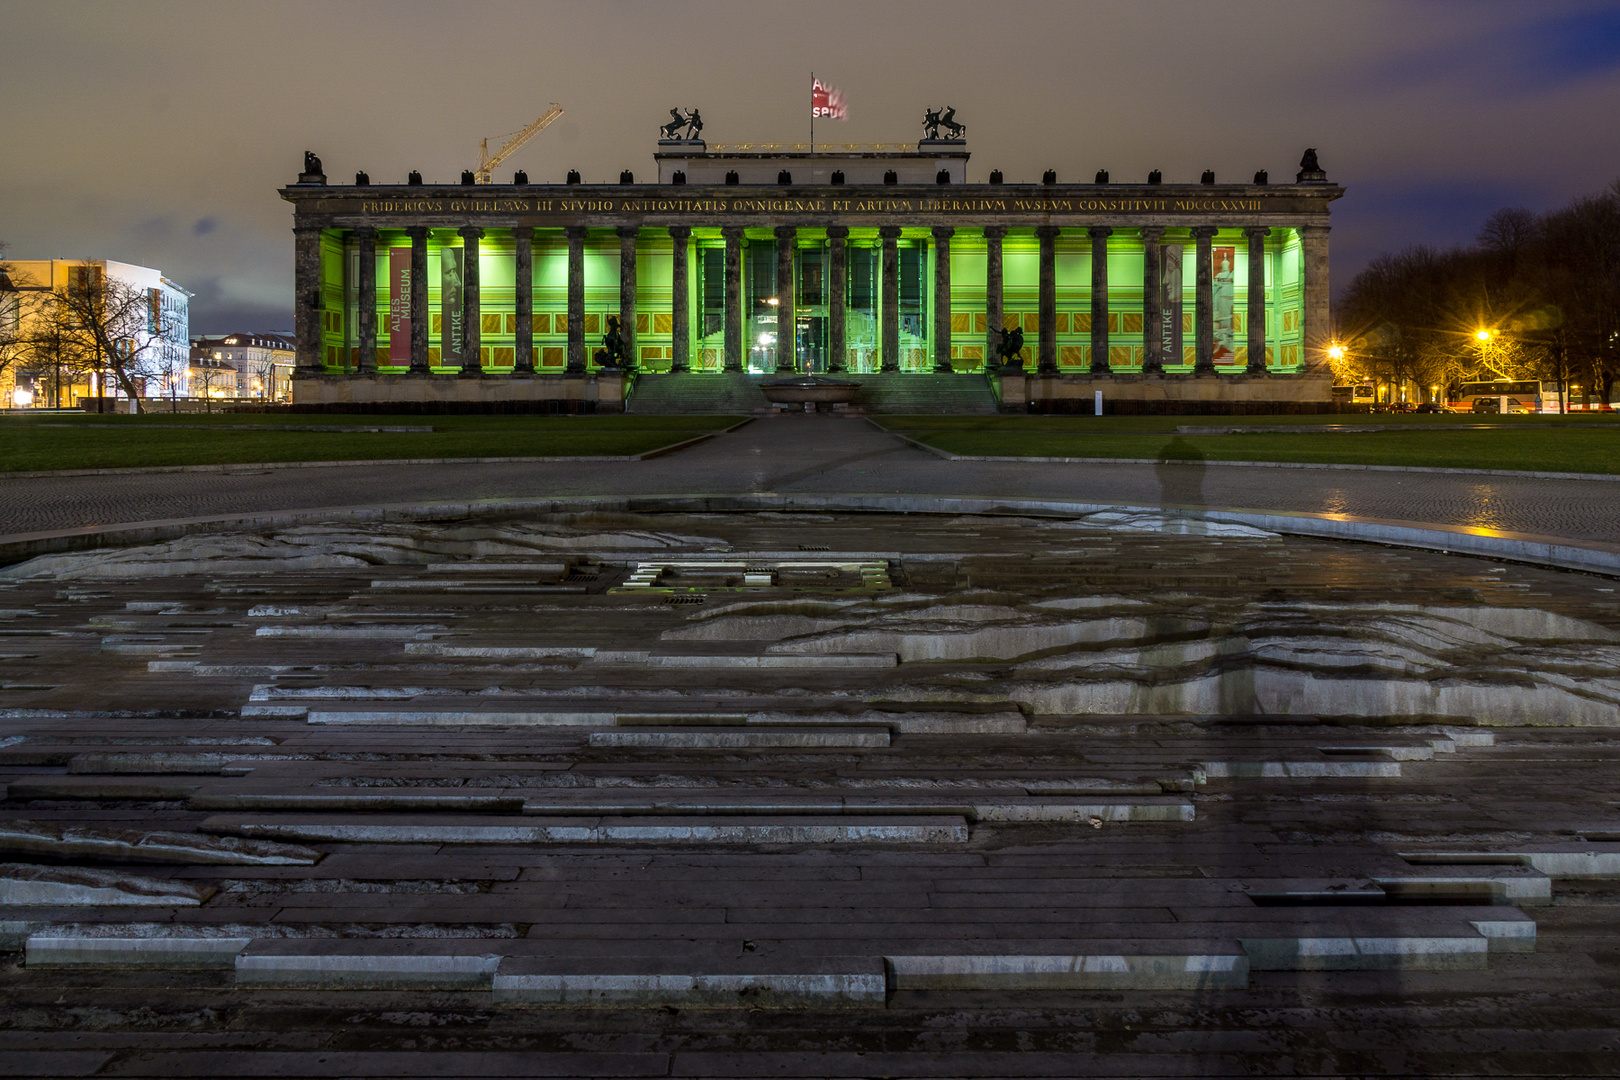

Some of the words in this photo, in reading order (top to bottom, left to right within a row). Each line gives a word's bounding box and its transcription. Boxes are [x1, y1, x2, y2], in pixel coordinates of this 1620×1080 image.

[362, 201, 442, 211] FRIDERICVS
[451, 200, 529, 211] GVILELMVS
[536, 200, 552, 211] III
[560, 200, 613, 211] STVDIO
[621, 200, 728, 211] ANTIQVITATIS
[733, 200, 826, 210] OMNIGENAE
[833, 200, 850, 210] ET
[856, 200, 912, 210] ARTIVM
[919, 200, 1006, 210] LIBERALIVM
[1013, 200, 1073, 210] MVSEVM
[1079, 200, 1168, 210] CONSTITVIT
[1173, 200, 1242, 210] MDCCCXXVIII
[391, 298, 400, 332] ALTES
[400, 269, 411, 319] MUSEUM
[451, 310, 462, 355] ANTIKE
[1162, 308, 1173, 353] ANTIKE
